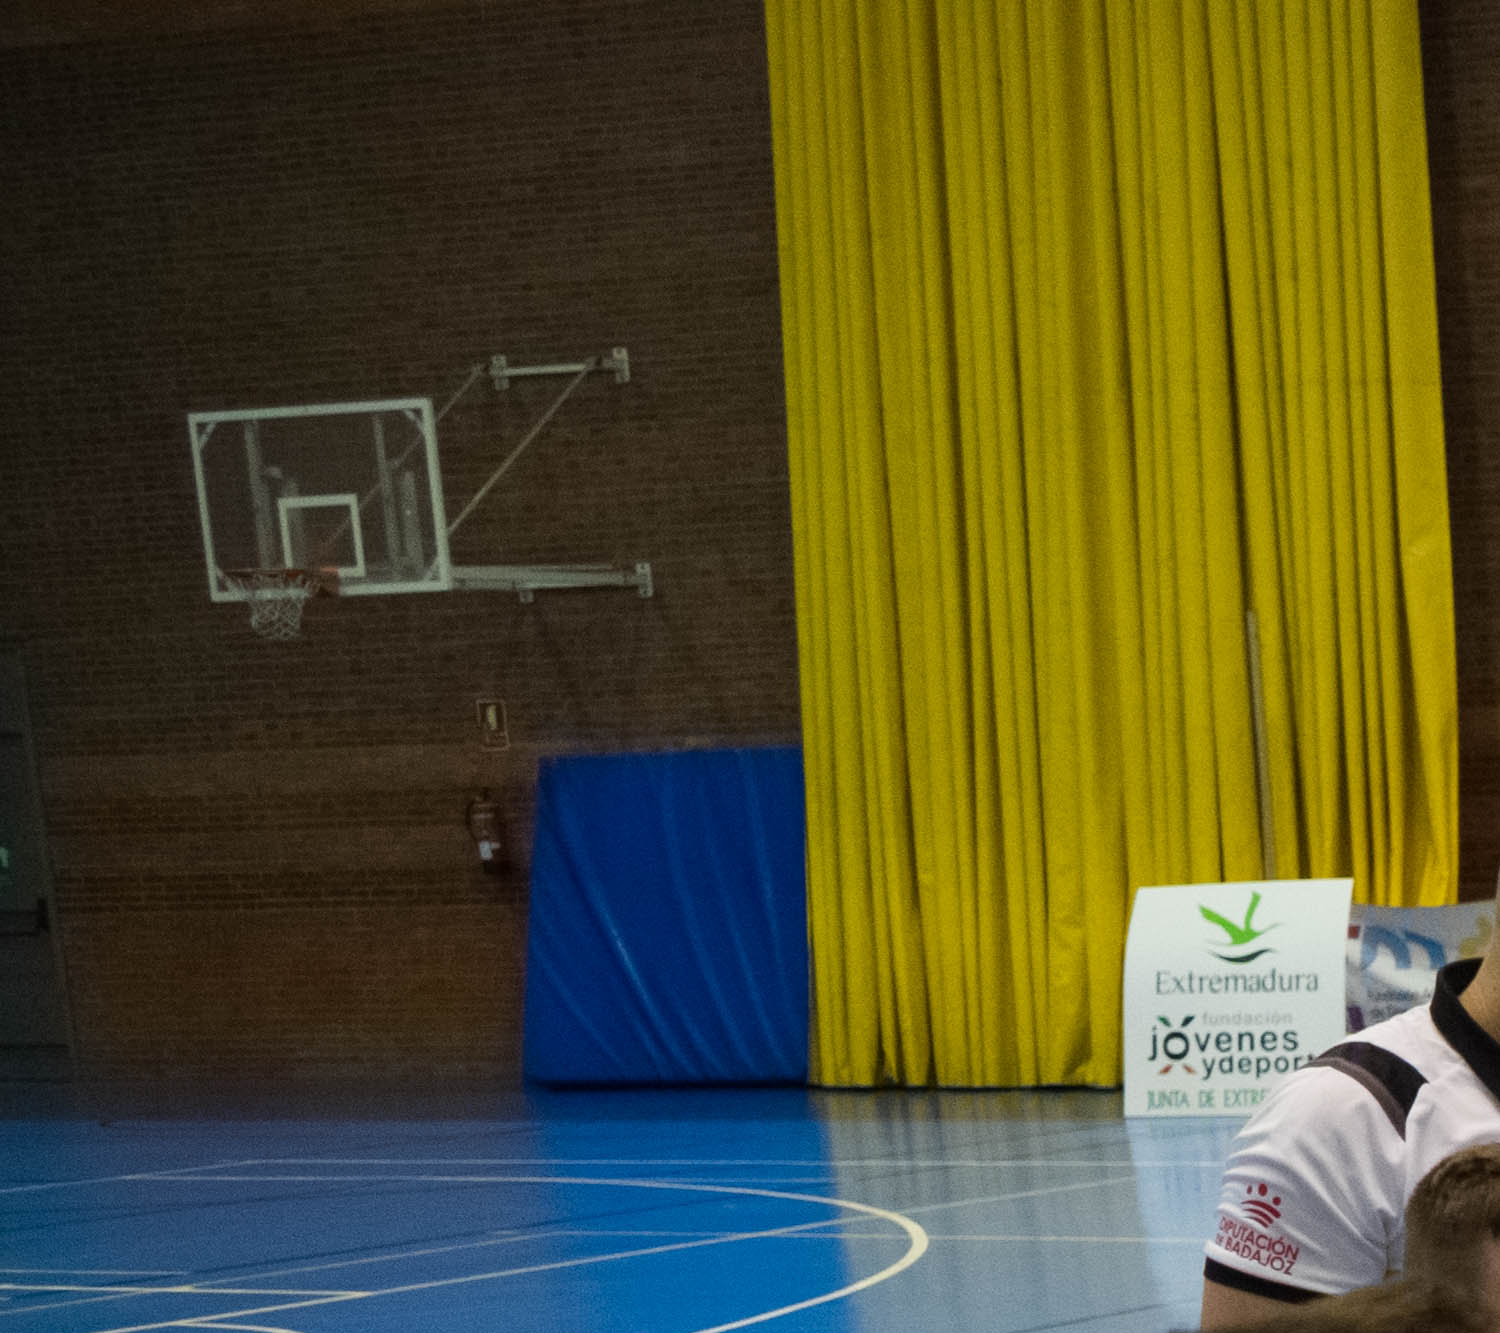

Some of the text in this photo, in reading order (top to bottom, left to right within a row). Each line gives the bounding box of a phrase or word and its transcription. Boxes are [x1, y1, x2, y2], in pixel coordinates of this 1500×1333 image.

[1155, 967, 1320, 997] Extremadura
[1202, 1009, 1294, 1027] fundación
[1148, 1090, 1190, 1111] JUNTA
[1199, 1090, 1216, 1109] DE
[1225, 1236, 1294, 1276] BADAJOZ
